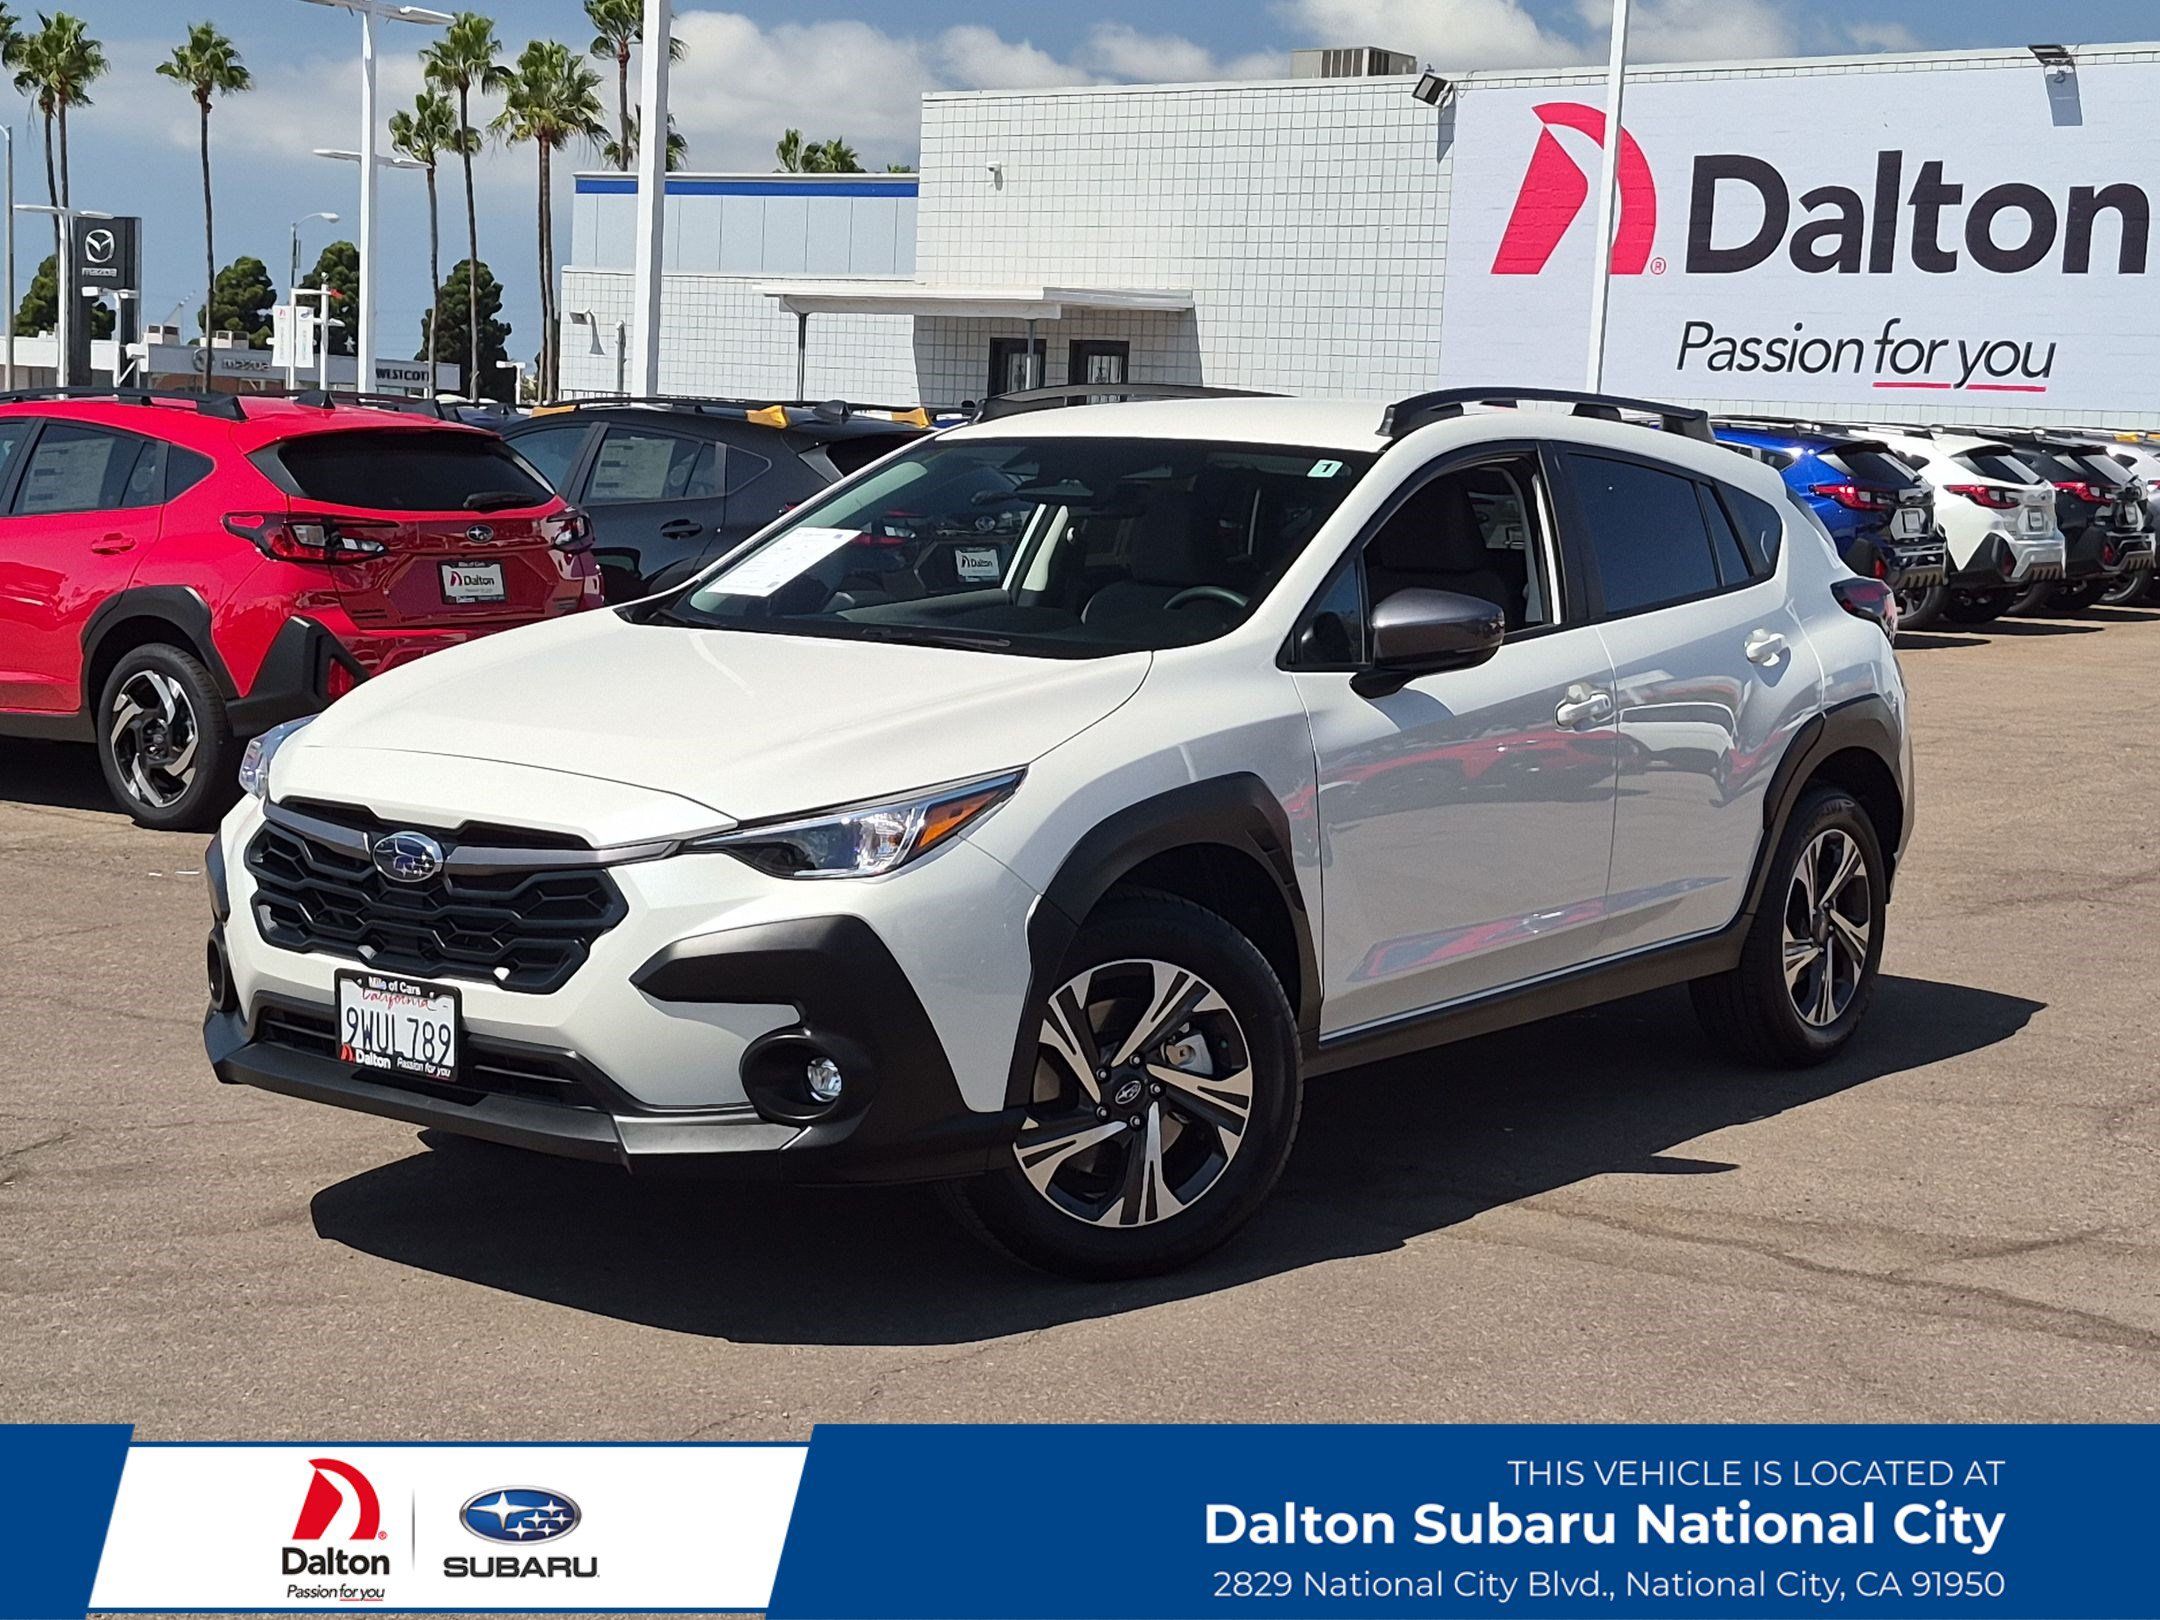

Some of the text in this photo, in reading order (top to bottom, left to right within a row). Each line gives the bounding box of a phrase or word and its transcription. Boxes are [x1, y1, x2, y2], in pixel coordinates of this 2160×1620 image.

[1685, 149, 2150, 275] Dalton
[1676, 318, 2057, 390] Passion for you
[1321, 463, 1333, 473] 1
[464, 574, 495, 586] Dalton
[368, 976, 420, 996] Mile of Cars
[355, 1049, 451, 1077] Dalton Passion for you
